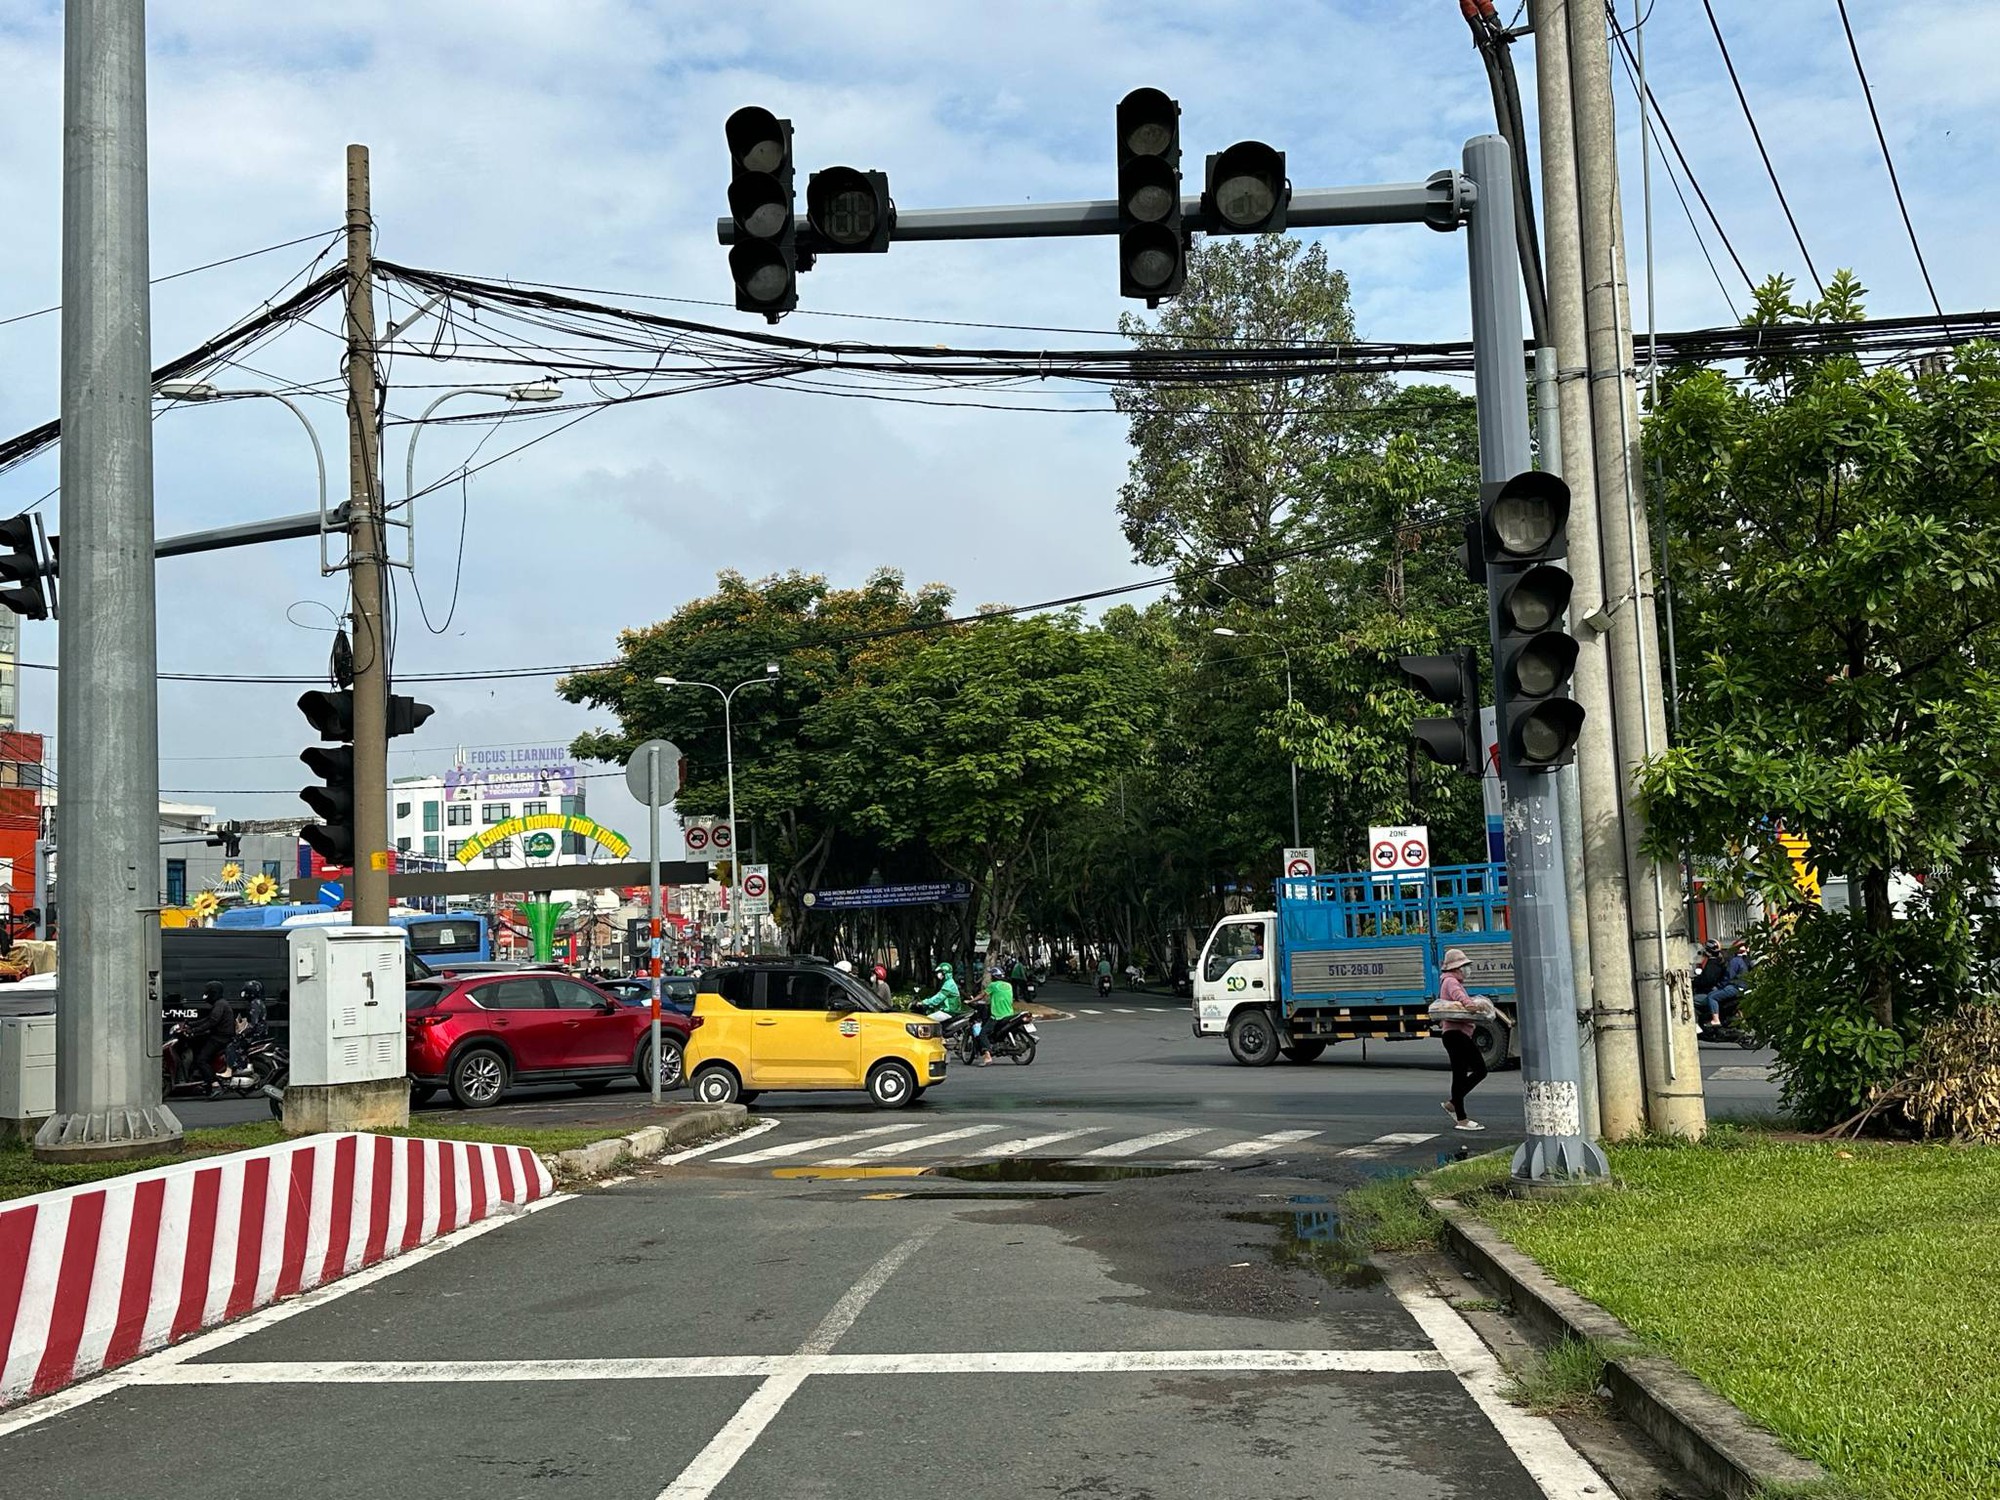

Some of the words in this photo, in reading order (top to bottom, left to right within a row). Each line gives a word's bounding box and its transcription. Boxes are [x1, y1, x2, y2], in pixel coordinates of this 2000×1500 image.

[471, 750, 506, 763] FOCUS
[511, 747, 565, 762] LEARNING
[488, 772, 535, 783] ENGLISH
[1290, 850, 1309, 858] ZONE
[746, 866, 763, 874] ZONE
